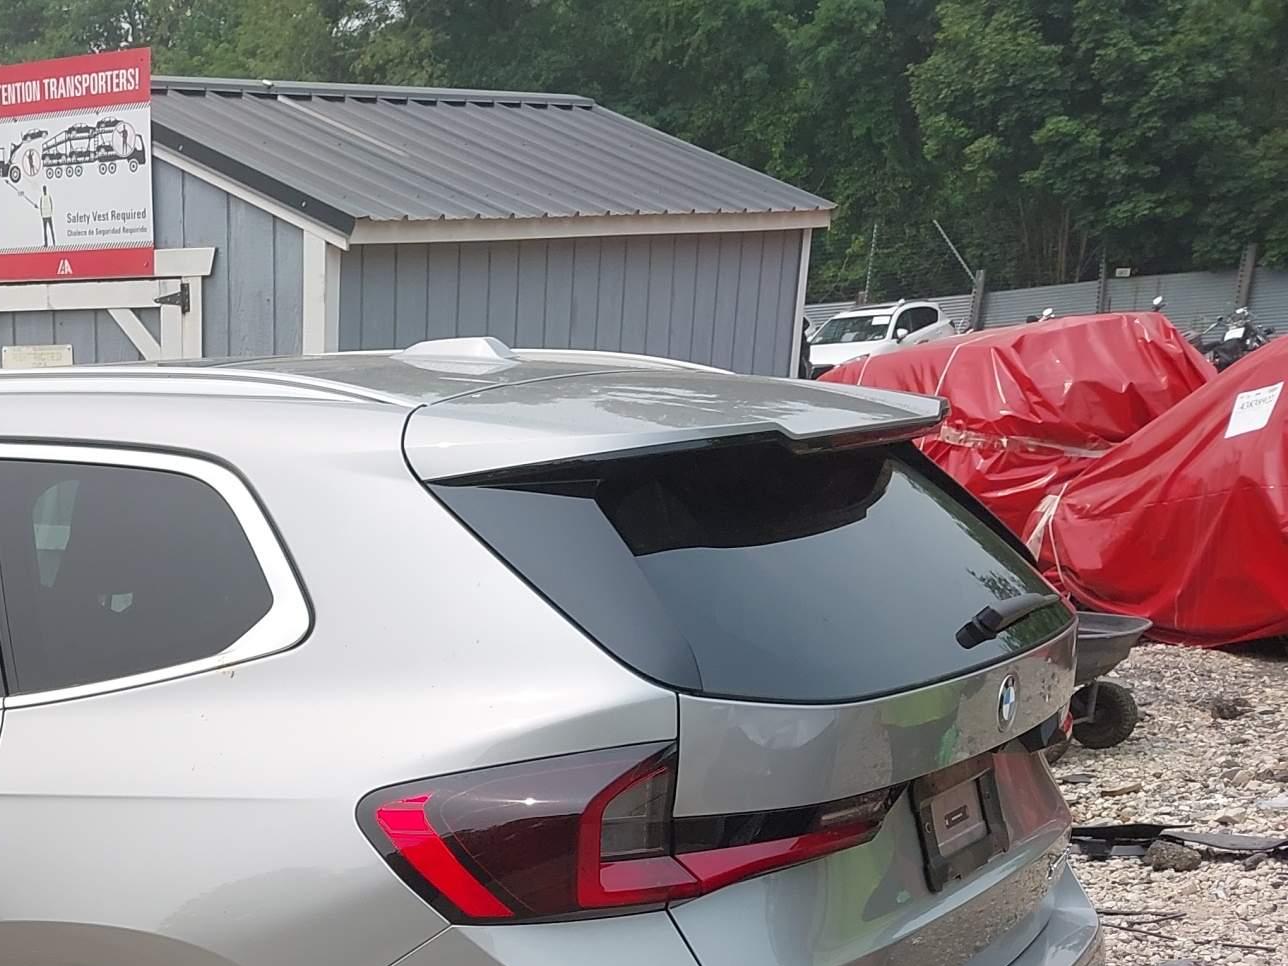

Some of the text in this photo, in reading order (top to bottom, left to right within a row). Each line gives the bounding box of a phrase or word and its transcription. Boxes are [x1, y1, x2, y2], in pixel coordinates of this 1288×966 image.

[42, 67, 140, 101] TRANSPORTERS!
[92, 210, 110, 221] Vest
[111, 208, 147, 223] Required
